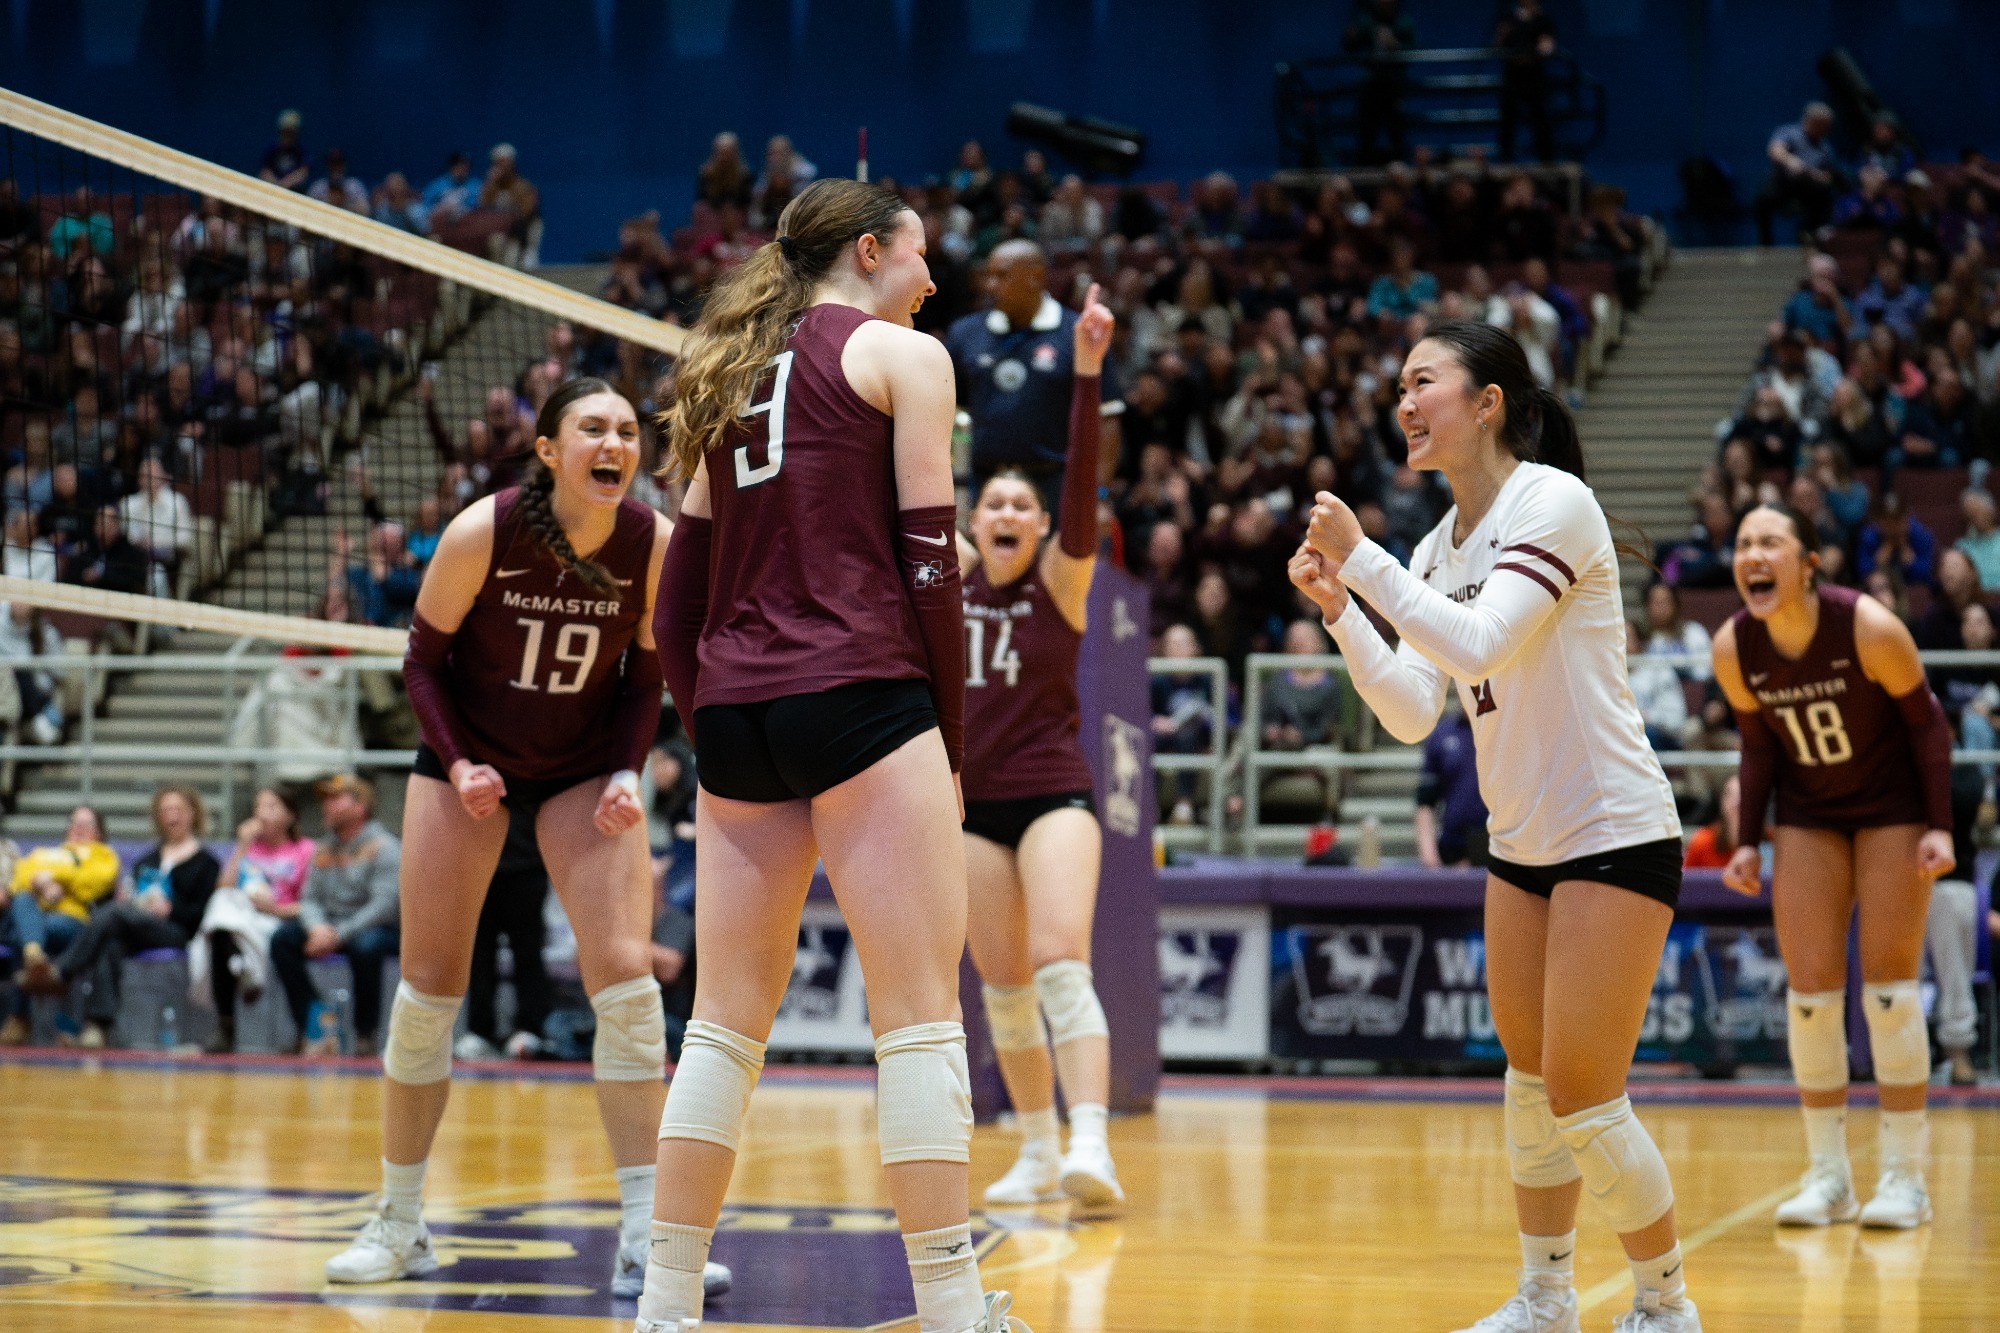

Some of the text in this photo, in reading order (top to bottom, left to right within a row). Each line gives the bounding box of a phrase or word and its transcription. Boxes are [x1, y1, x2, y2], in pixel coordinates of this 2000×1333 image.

[734, 350, 795, 490] 9
[502, 590, 621, 616] McMASTER
[509, 617, 601, 693] 19
[963, 619, 1022, 688] 14
[1774, 701, 1852, 767] 18
